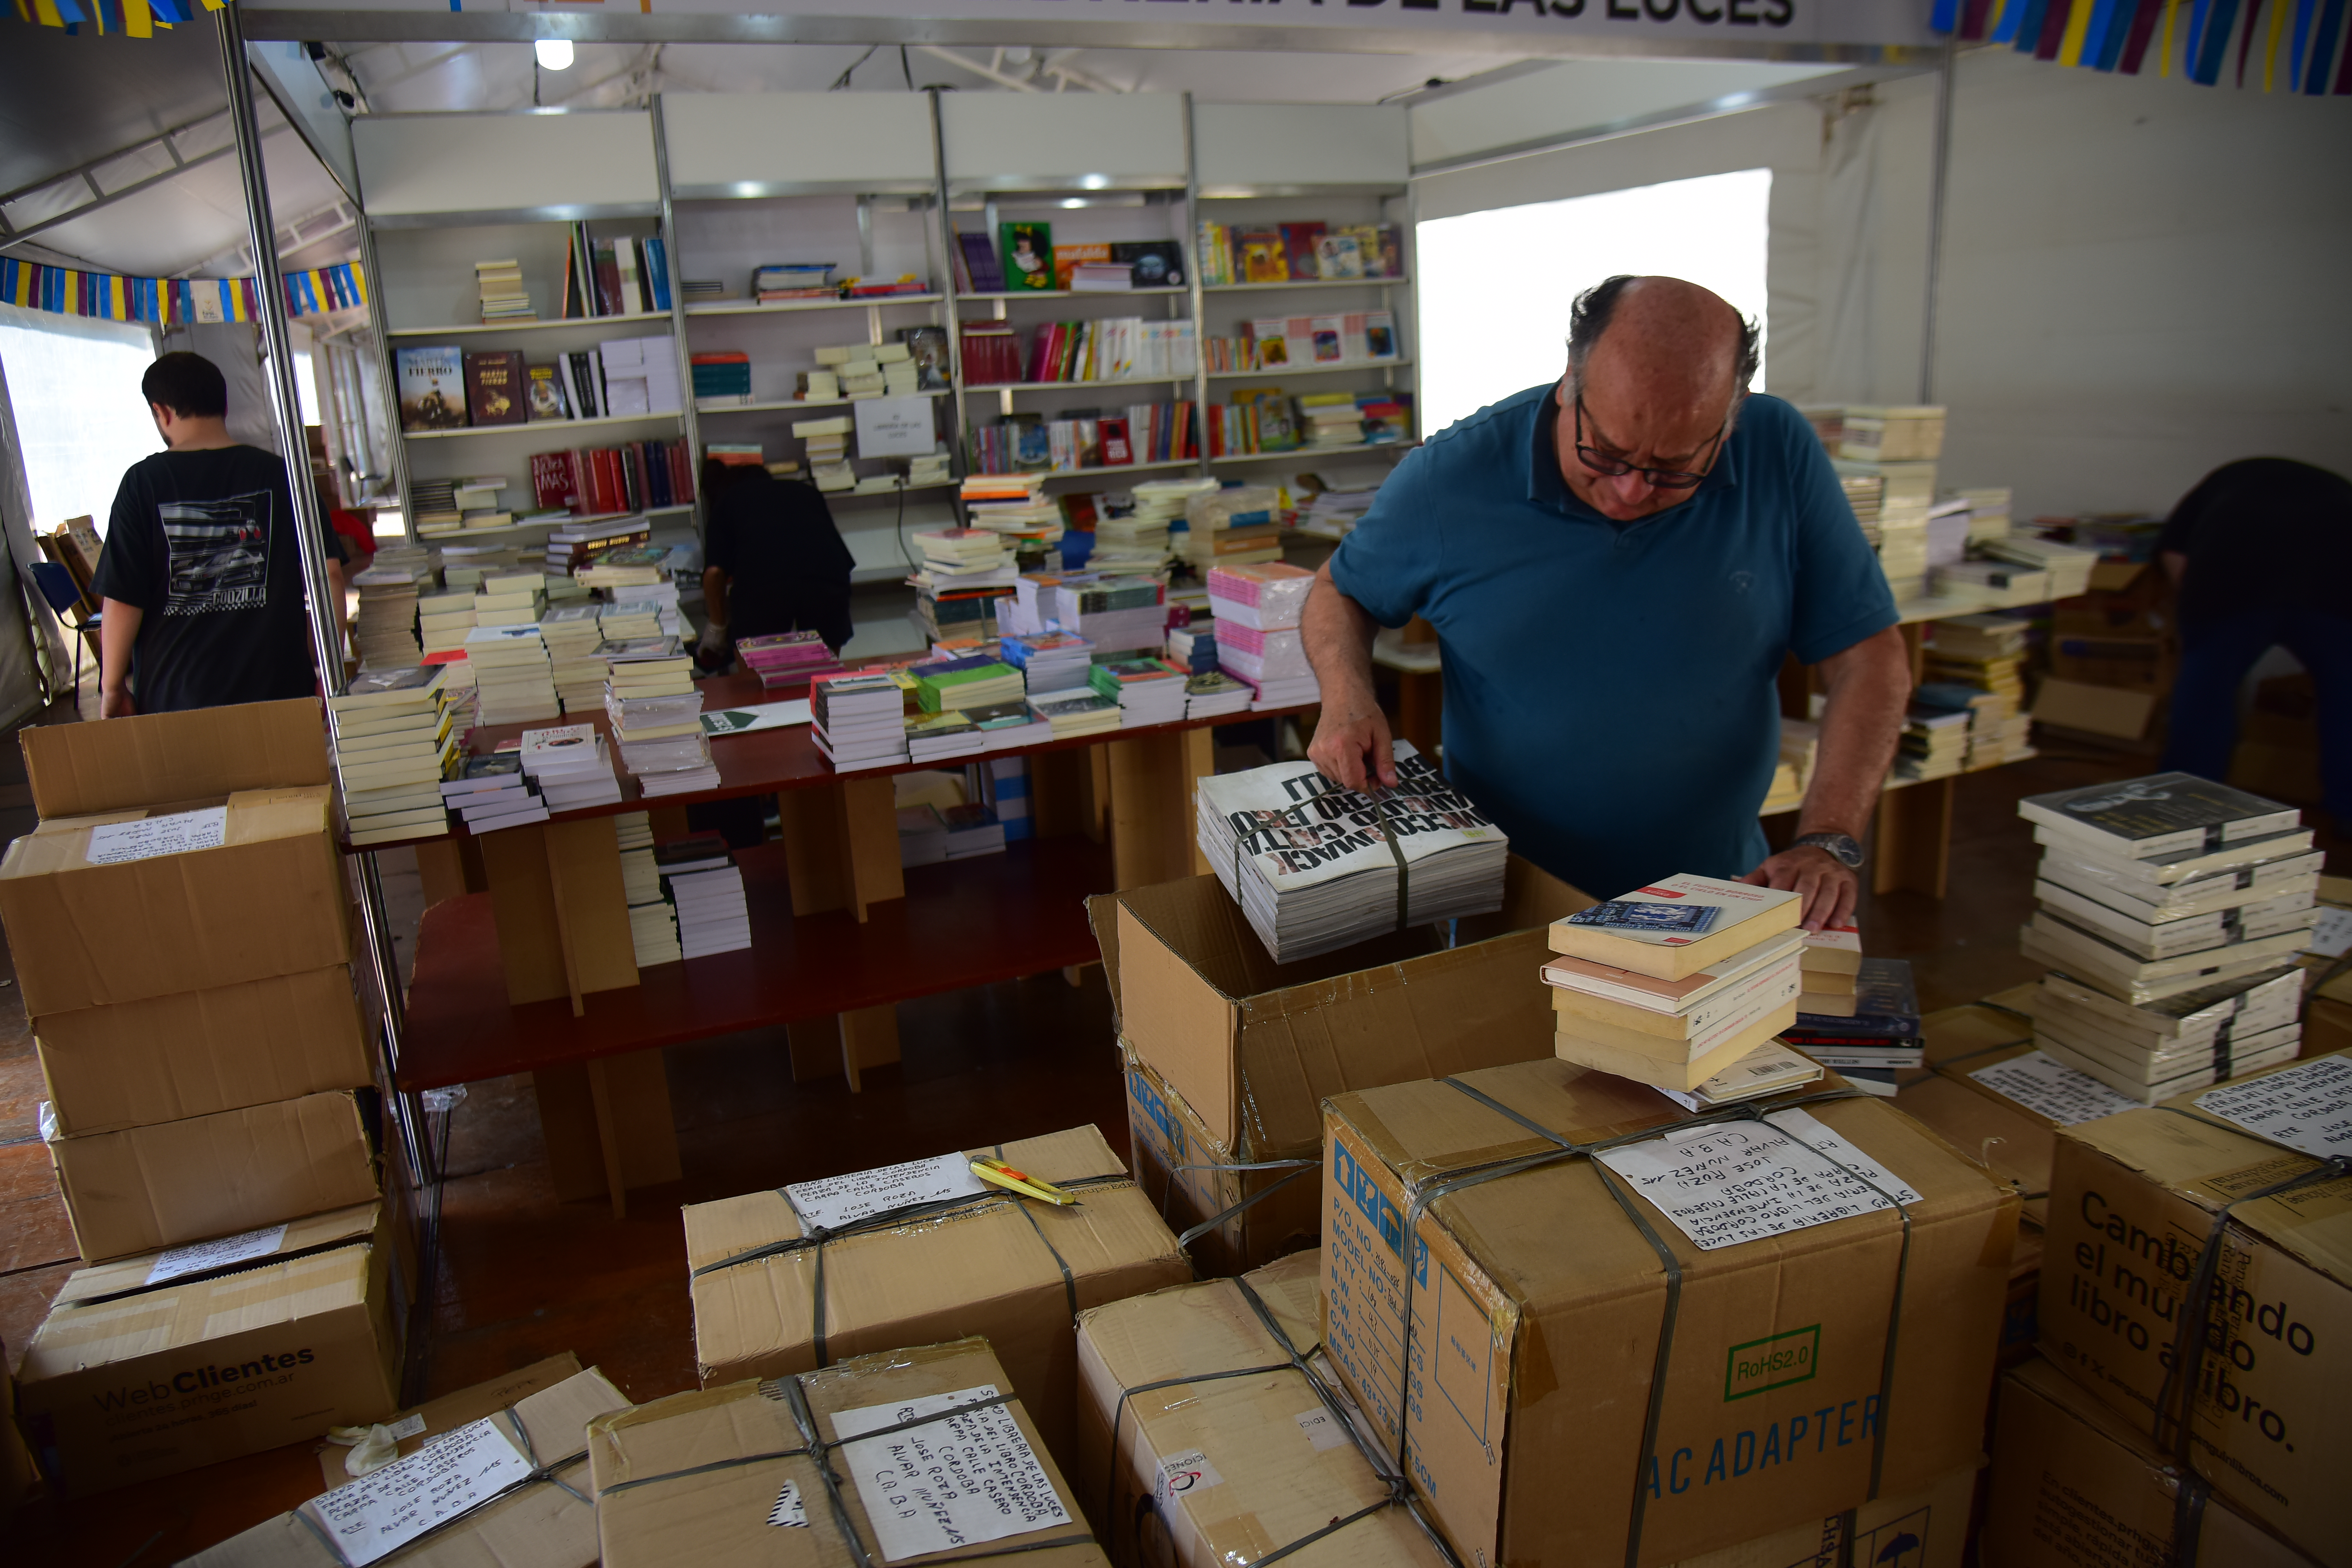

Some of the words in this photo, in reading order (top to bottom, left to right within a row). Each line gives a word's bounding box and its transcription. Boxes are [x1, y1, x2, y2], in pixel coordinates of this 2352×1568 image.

[213, 587, 266, 606] GODZILLA
[1693, 884, 1724, 892] FUTURO
[2243, 1088, 2264, 1100] DEL
[2296, 1064, 2349, 1082] CORDOBA
[2219, 1102, 2262, 1118] PLAZA
[2260, 1096, 2279, 1107] DE
[2279, 1092, 2296, 1100] LA
[2240, 1109, 2284, 1124] CARPA
[2291, 1100, 2352, 1120] CORDOBA
[1741, 1134, 1790, 1156] ALVAR
[882, 1163, 926, 1176] CORDOBA
[1732, 1156, 1771, 1173] JOSE
[790, 1180, 823, 1190] STAND
[800, 1187, 831, 1198] PLAZA
[804, 1191, 840, 1202] CARPA
[846, 1183, 876, 1193] CALLE
[883, 1172, 931, 1184] CASEROS
[855, 1182, 905, 1196] CORDOBA
[1071, 1186, 1110, 1196] Grupo
[1721, 1167, 1800, 1196] CORDOBA
[1769, 1183, 1788, 1191] LA
[1792, 1176, 1809, 1186] DE
[1806, 1184, 1823, 1192] DE
[844, 1202, 871, 1212] JOSE
[882, 1190, 916, 1202] ROZA
[1725, 1188, 1768, 1204] CALLE
[1787, 1190, 1804, 1199] LA
[1803, 1194, 1831, 1205] DEL
[1871, 1190, 1914, 1208] STND
[839, 1209, 878, 1220] ALVAR
[951, 1205, 1006, 1224] Editorial
[1672, 1200, 1725, 1217] CASEROS
[1692, 1216, 1757, 1241] CORDOBA
[1738, 1228, 1765, 1238] LAS
[1768, 1222, 1786, 1231] DE
[1332, 1218, 1366, 1274] MODEL
[1356, 1224, 1374, 1257] NO.
[1693, 1234, 1736, 1251] LUCES
[2081, 1190, 2315, 1356] Cambando
[2070, 1272, 2148, 1352] libro
[2075, 1241, 2104, 1277] el
[2114, 1265, 2255, 1372] mudo
[1408, 1345, 1424, 1372] CS
[1737, 1346, 1809, 1382] RoHS2.0
[92, 1348, 315, 1413] WebClientes
[105, 1371, 295, 1427] clientes.prhge.com.ar
[1704, 1393, 1881, 1486] ADAPTER
[315, 1484, 355, 1505] STAND
[425, 1444, 441, 1454] DE
[443, 1435, 462, 1444] LAS
[463, 1419, 489, 1435] LUCES
[360, 1481, 379, 1493] DEL
[422, 1434, 477, 1462] CORDOBA
[887, 1445, 920, 1479] ALVAR
[911, 1437, 934, 1462] JOSE
[928, 1466, 958, 1499] ROZA
[938, 1446, 981, 1494] CORDOBA
[983, 1425, 999, 1440] DEL
[1010, 1470, 1049, 1519] CORDOBA
[2190, 1431, 2289, 1507] penguinlibros.com
[333, 1499, 378, 1521] CARPA
[382, 1477, 423, 1496] CALLE
[426, 1447, 476, 1474] CASEROS
[395, 1463, 459, 1496] CORDOBA
[962, 1447, 986, 1474] CALLE
[983, 1479, 1012, 1515] CASERO
[1031, 1473, 1048, 1489] LAS
[328, 1494, 373, 1517] PLAZA
[377, 1483, 391, 1493] DE
[395, 1474, 411, 1483] LA
[392, 1495, 421, 1516] JOSE
[430, 1474, 466, 1494] ROZA
[1039, 1490, 1063, 1517] LUCES
[380, 1510, 418, 1534] ALVAR
